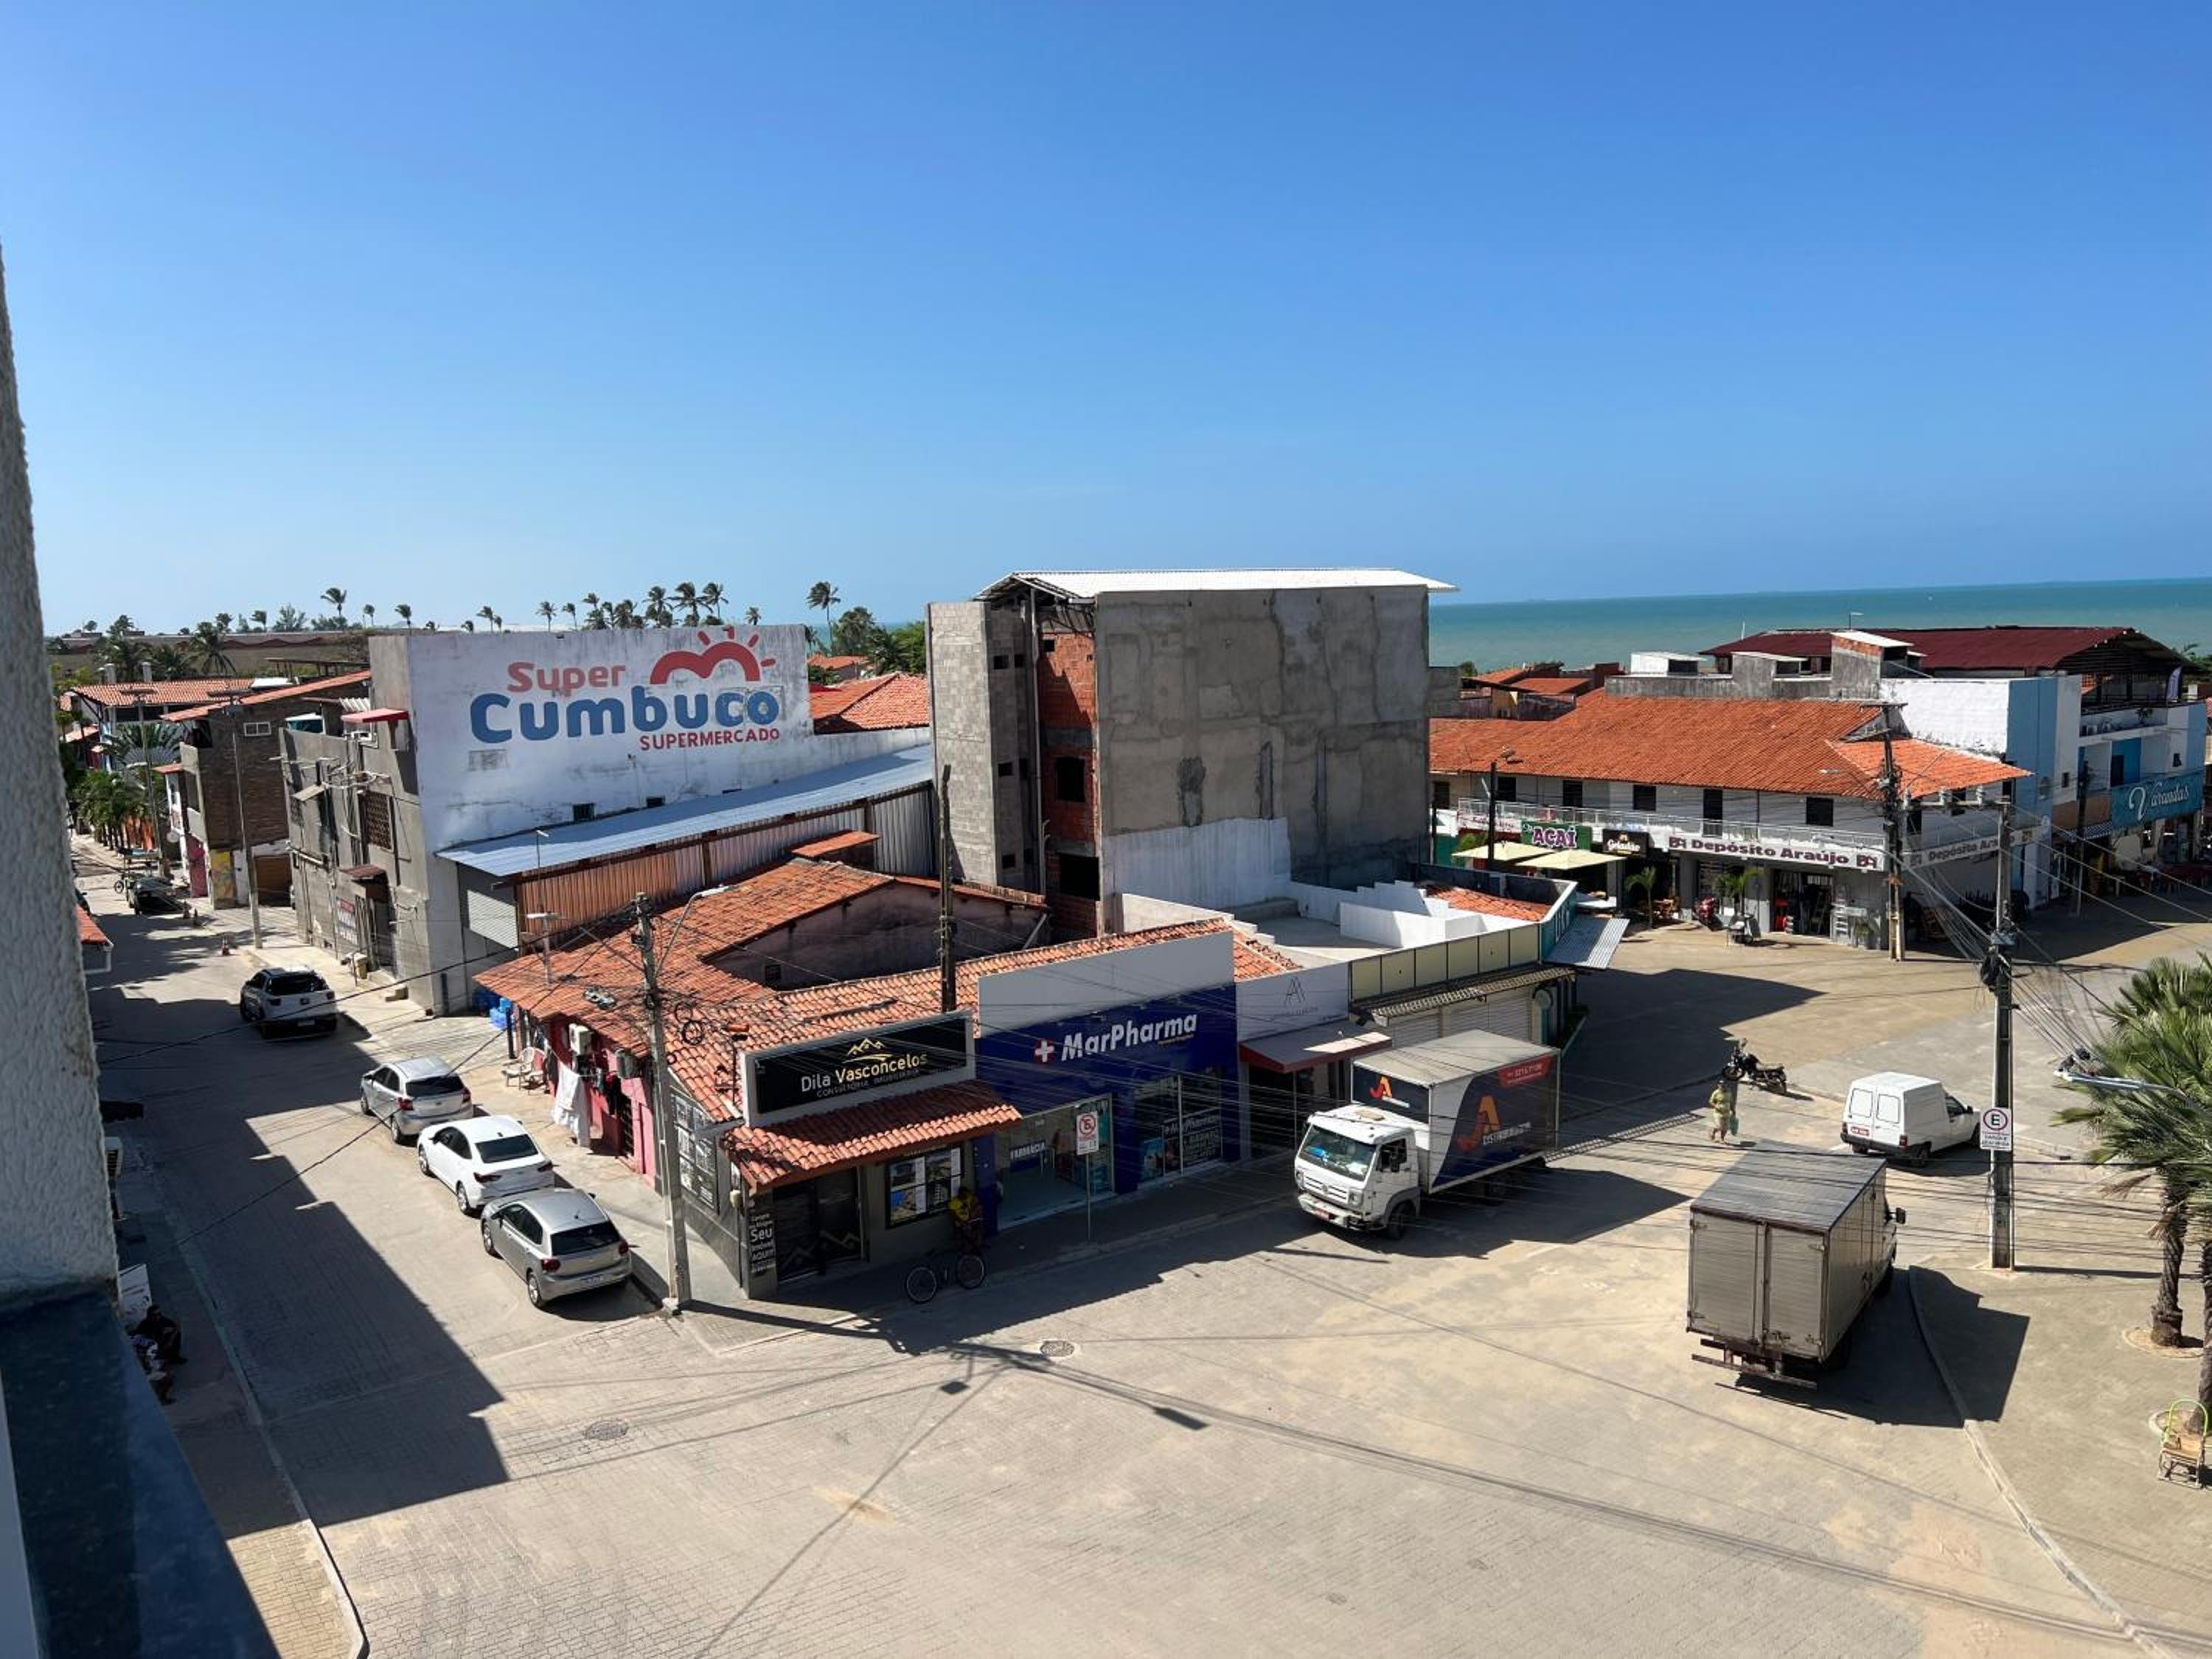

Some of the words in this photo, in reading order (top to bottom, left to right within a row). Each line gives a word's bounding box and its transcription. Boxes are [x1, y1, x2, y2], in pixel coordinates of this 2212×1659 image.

[507, 661, 626, 693] Super
[470, 686, 780, 743] Cumbuco
[639, 727, 780, 751] SUPERMERCADO
[1532, 826, 1577, 849] AÇAÍ
[1691, 839, 1775, 857] Depósito
[1780, 847, 1849, 865] Araújo
[1928, 844, 1977, 861] Depósito
[1061, 1015, 1197, 1061] MarPharma
[801, 1074, 831, 1093] Dila
[835, 1054, 928, 1084] Vasconcelos
[1992, 1114, 2000, 1126] E
[751, 1228, 772, 1242] Seu
